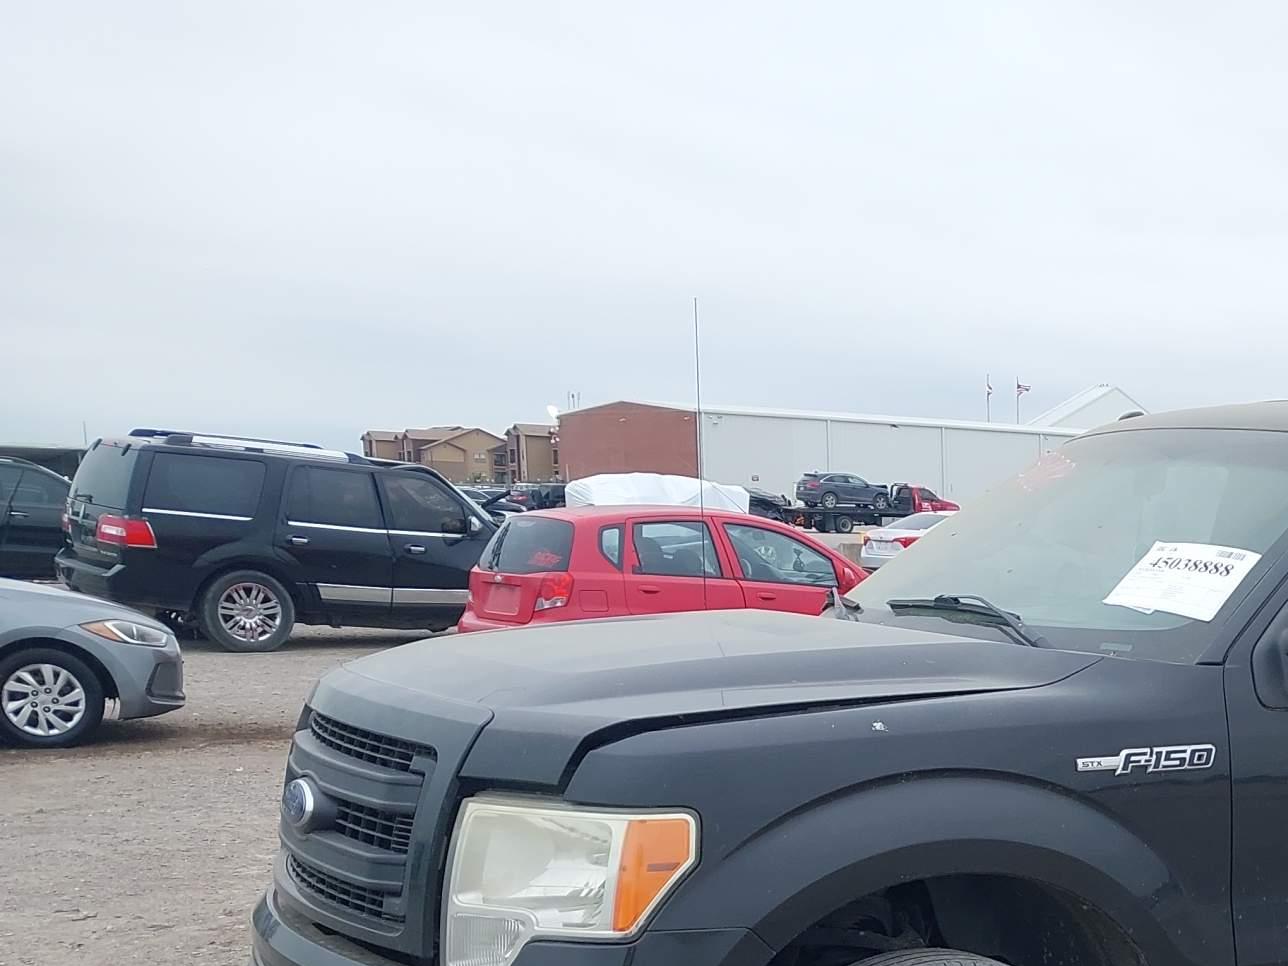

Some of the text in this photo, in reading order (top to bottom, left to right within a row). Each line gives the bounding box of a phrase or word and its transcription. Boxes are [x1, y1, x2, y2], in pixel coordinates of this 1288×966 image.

[1149, 556, 1235, 577] 45038888
[1081, 744, 1216, 775] STX F-150
